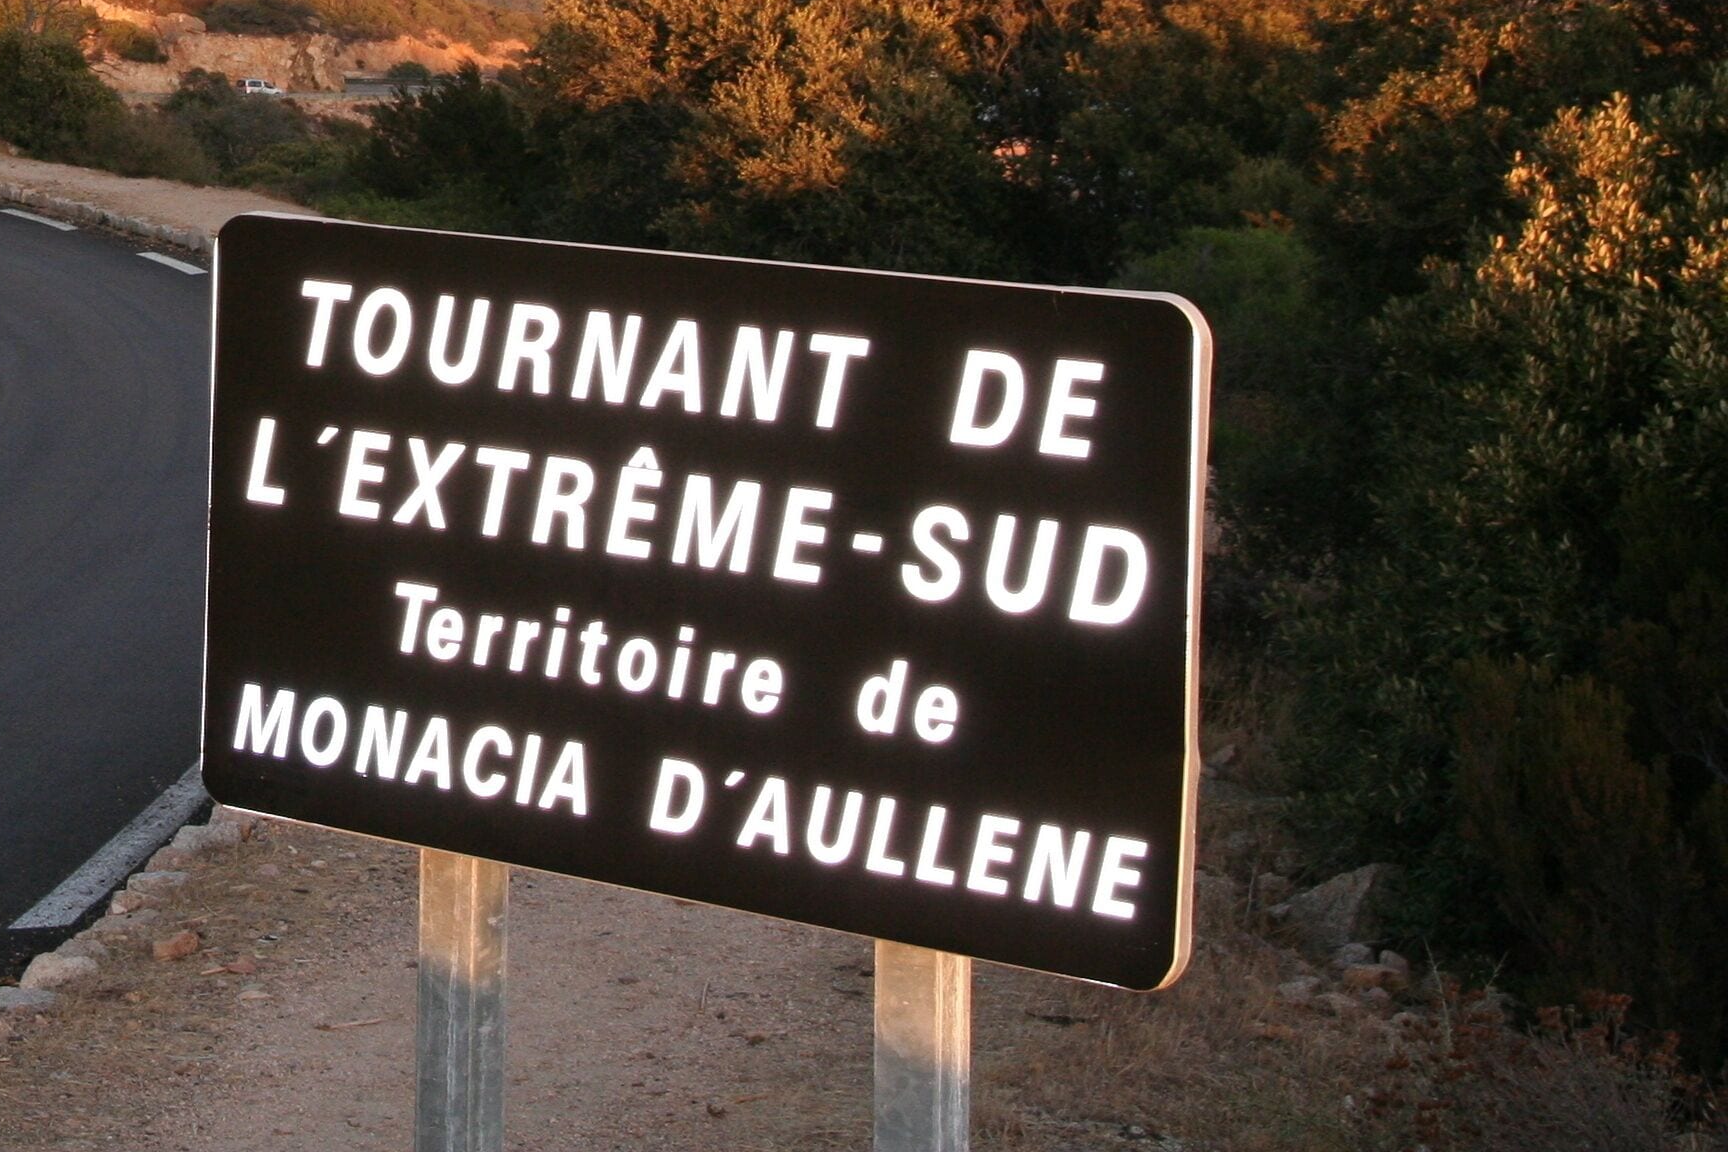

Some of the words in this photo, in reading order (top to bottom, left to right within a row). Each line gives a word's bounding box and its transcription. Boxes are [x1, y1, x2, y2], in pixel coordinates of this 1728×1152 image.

[301, 278, 872, 430] TOURNANT
[948, 348, 1106, 461] DE
[393, 580, 785, 716] Territoire
[855, 658, 960, 745] de
[232, 682, 589, 817] MONACIA
